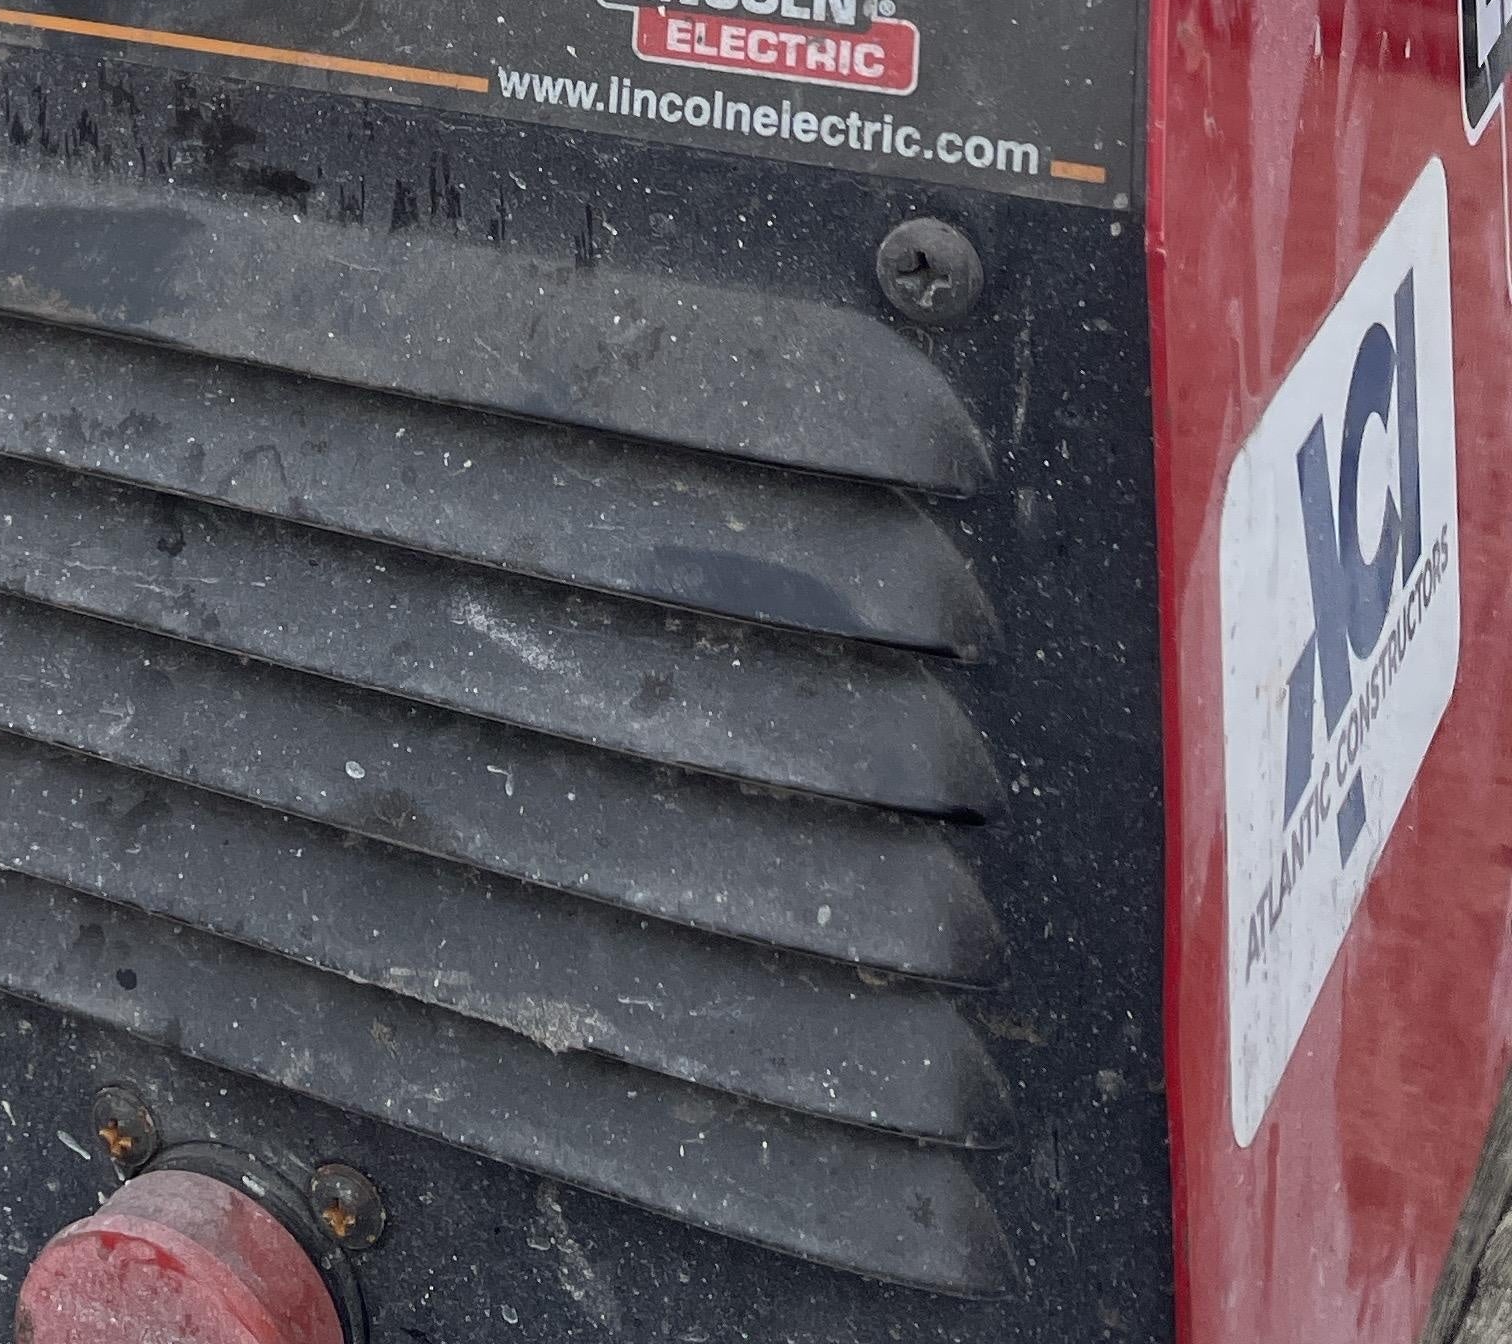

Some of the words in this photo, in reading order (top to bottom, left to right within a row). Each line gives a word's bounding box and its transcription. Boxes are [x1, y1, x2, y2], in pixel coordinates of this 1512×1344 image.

[665, 18, 886, 78] ELECTRIC
[497, 67, 1040, 175] www.lincolnelectric.com
[1245, 761, 1330, 987] ATLANTIC
[1337, 522, 1449, 787] CONSTRUCTORS
